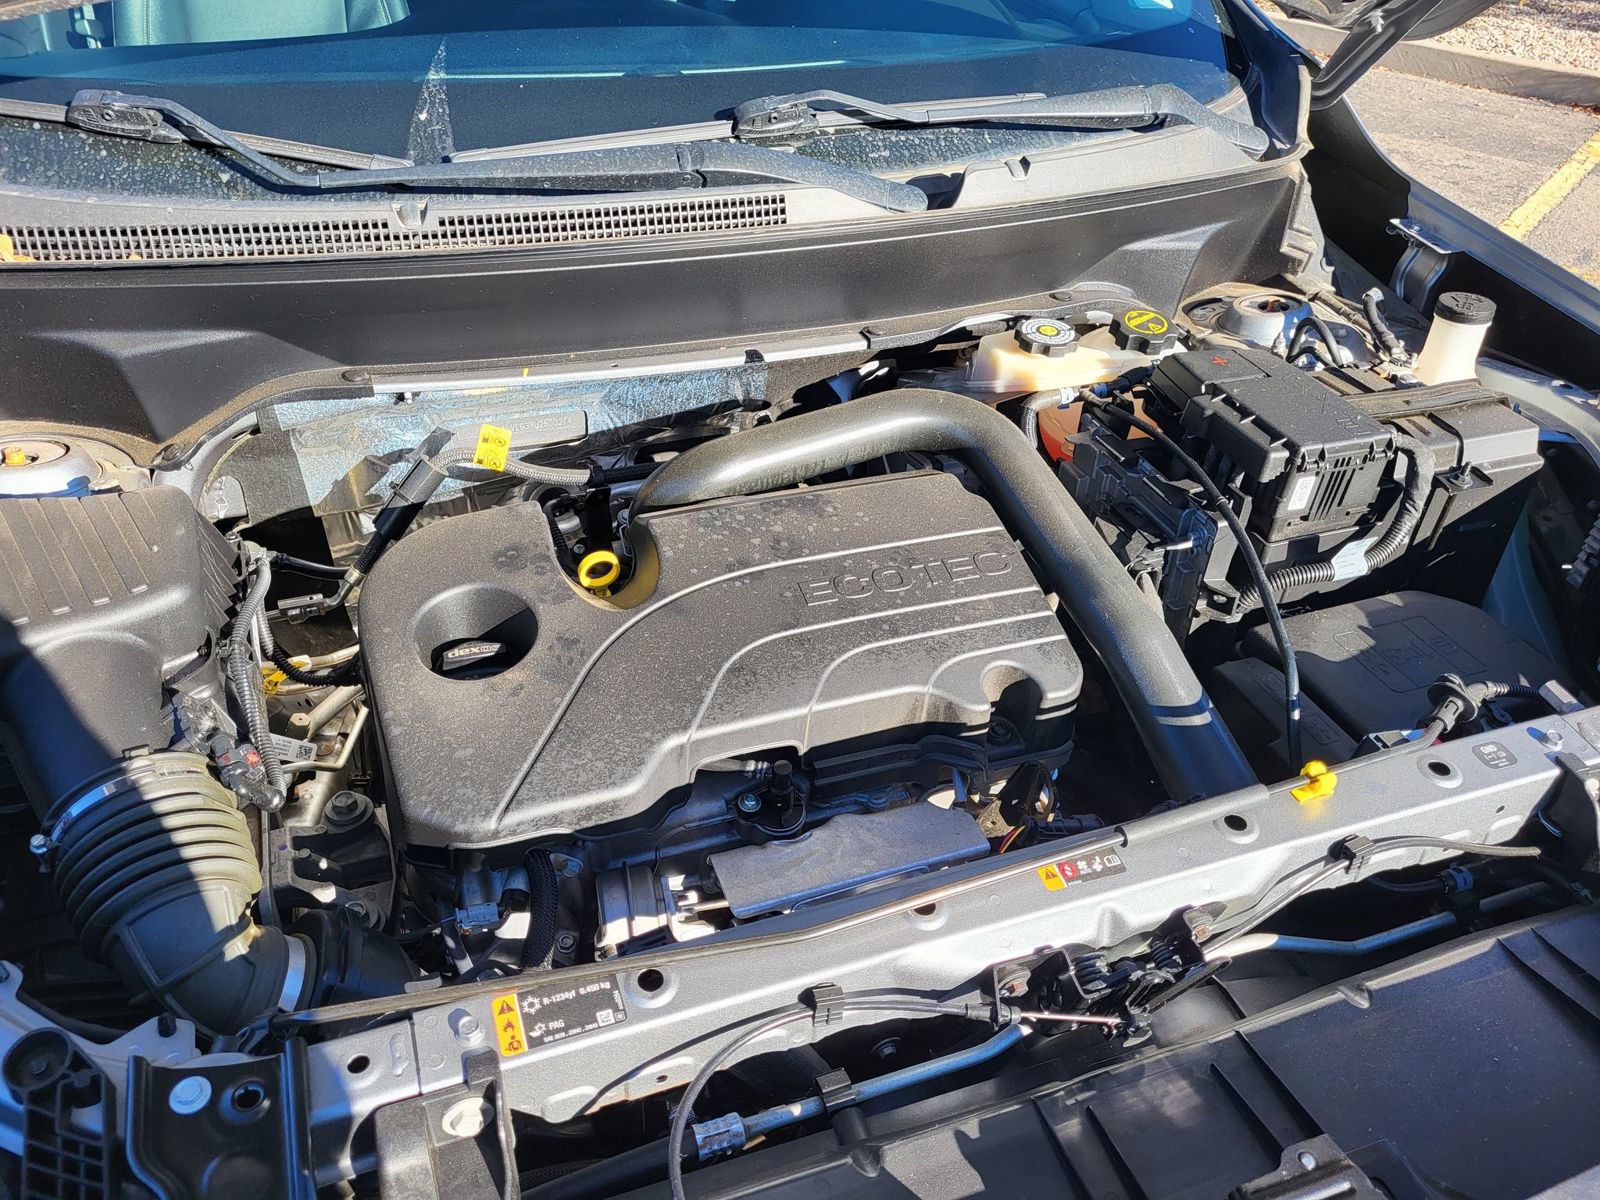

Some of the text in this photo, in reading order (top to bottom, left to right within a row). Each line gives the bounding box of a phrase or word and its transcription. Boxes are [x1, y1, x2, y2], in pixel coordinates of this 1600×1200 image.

[797, 552, 1013, 607] ECOTEC
[542, 981, 611, 1006] R-1234yf 0.450 kg
[548, 1019, 565, 1031] PAG
